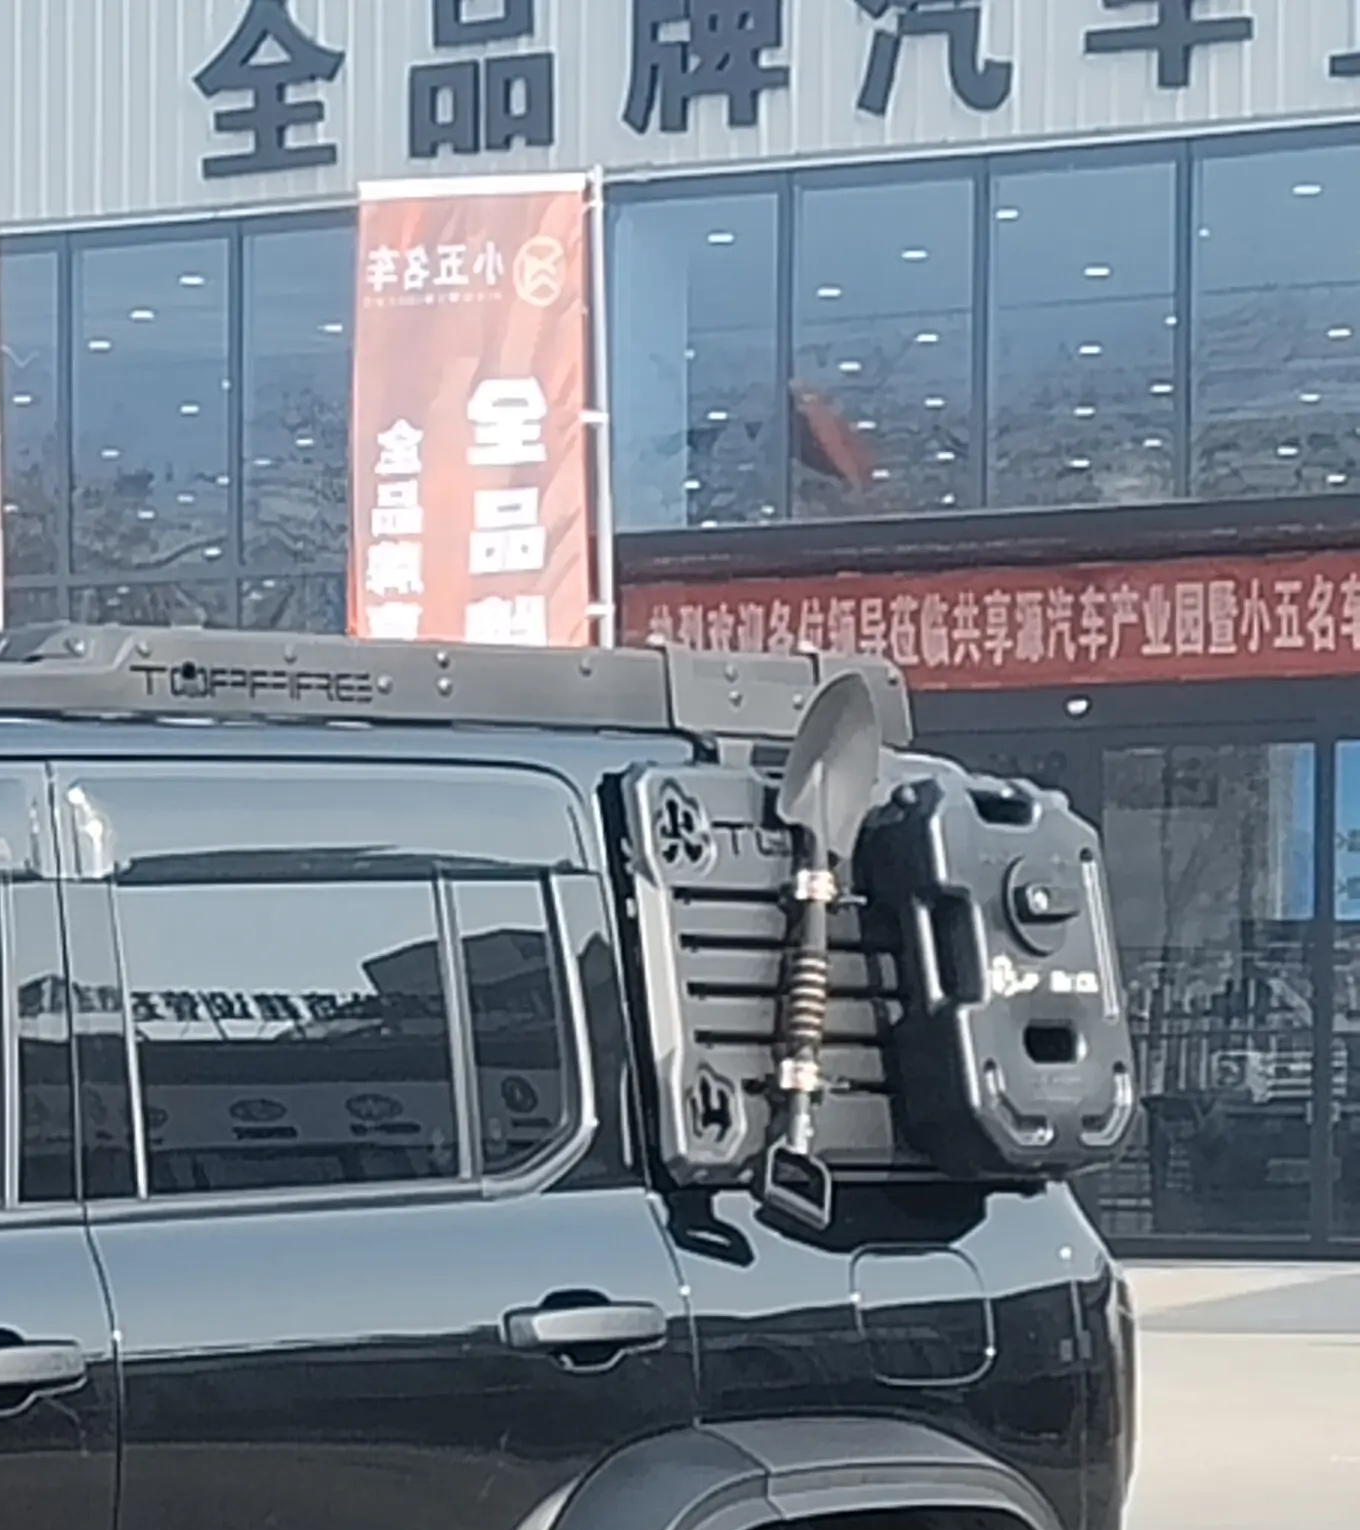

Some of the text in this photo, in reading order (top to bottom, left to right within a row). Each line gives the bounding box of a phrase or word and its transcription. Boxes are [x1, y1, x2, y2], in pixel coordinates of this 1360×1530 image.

[193, 0, 1360, 179] 全品牌汽车
[129, 663, 373, 702] TOPFIRE
